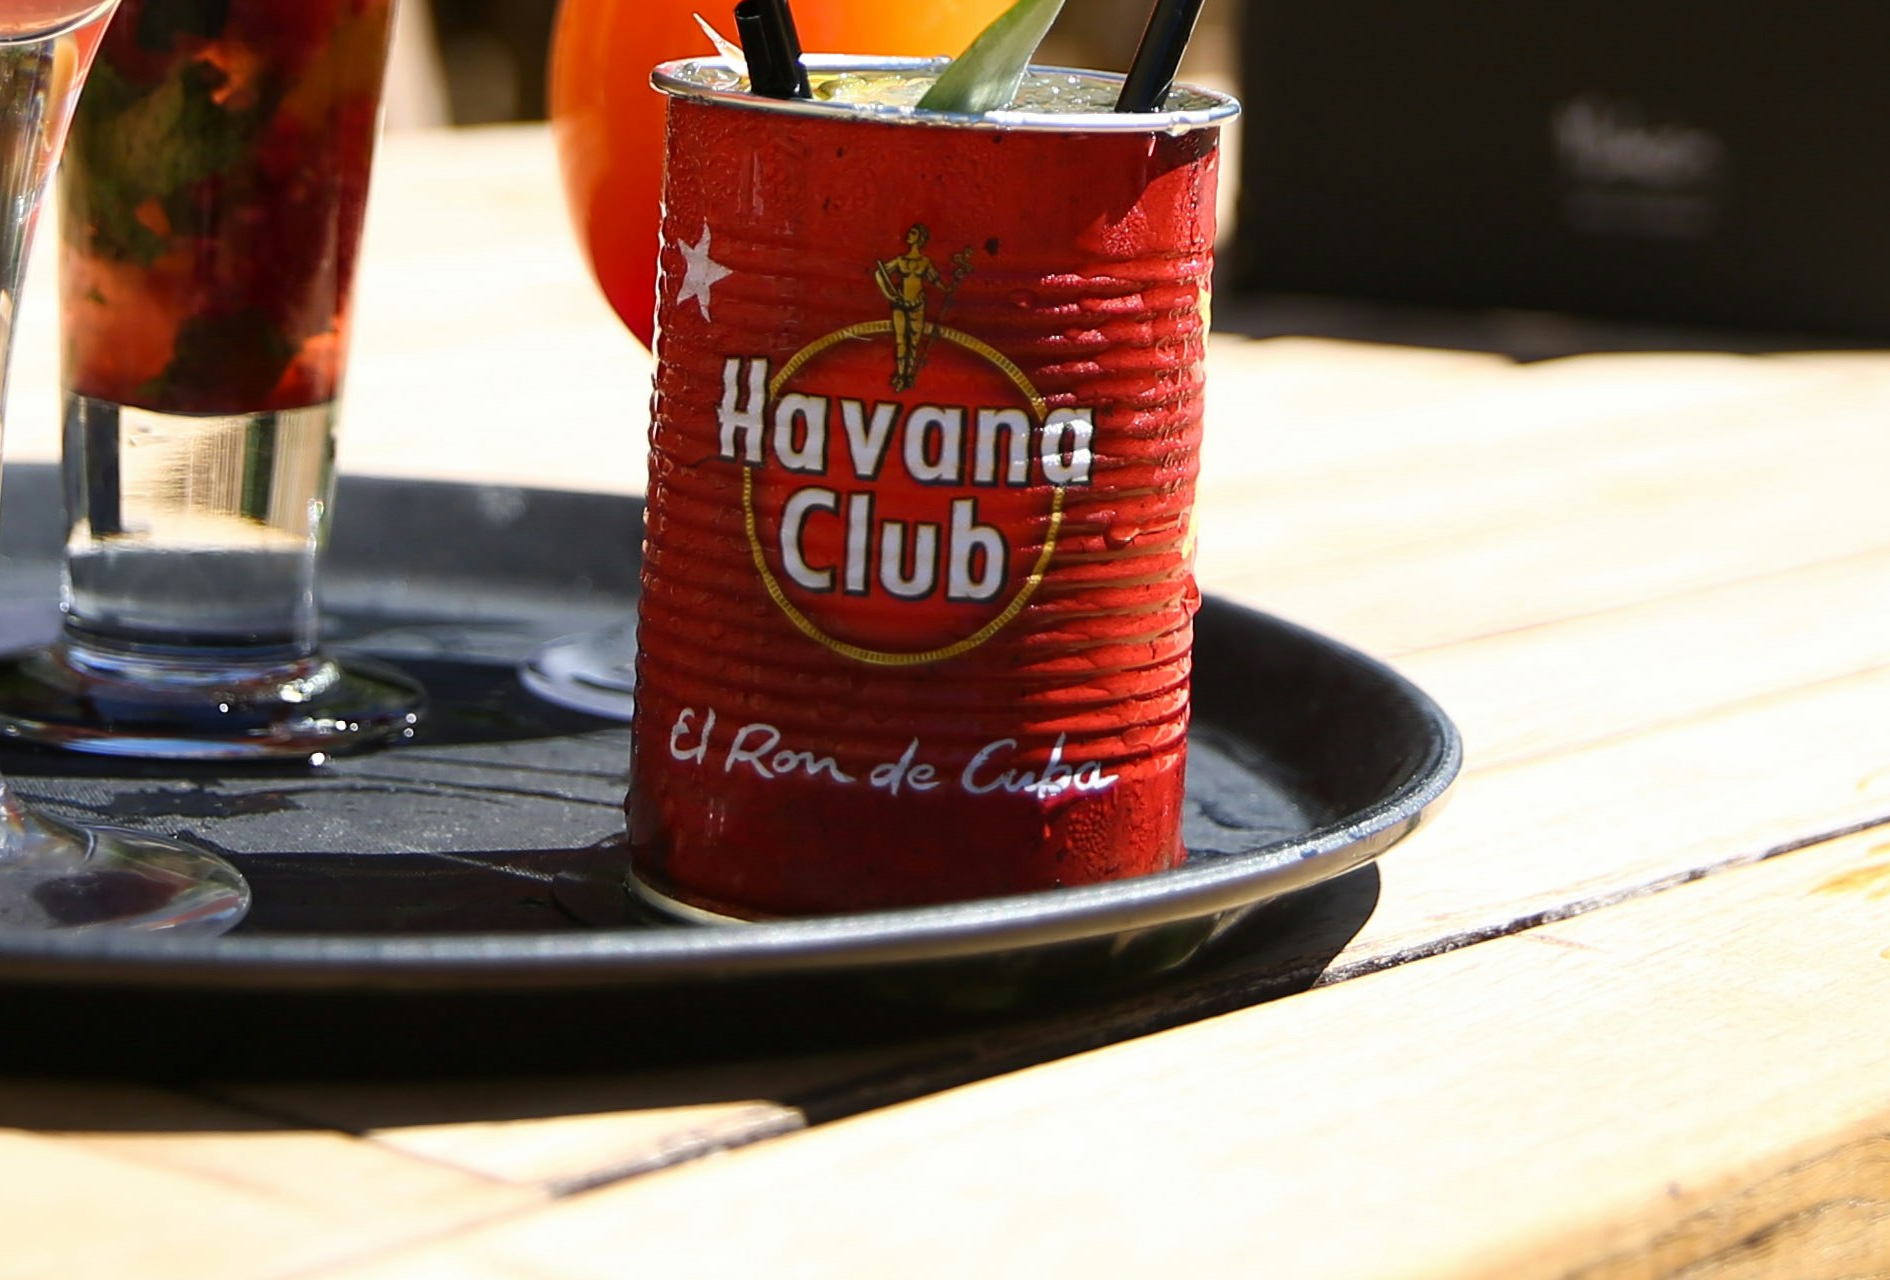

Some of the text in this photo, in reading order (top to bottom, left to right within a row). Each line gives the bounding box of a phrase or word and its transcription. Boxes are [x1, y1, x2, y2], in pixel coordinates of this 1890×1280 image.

[717, 357, 1096, 486] Havana
[779, 487, 1008, 601] Club
[670, 706, 1121, 799] El Ron de Cuba
